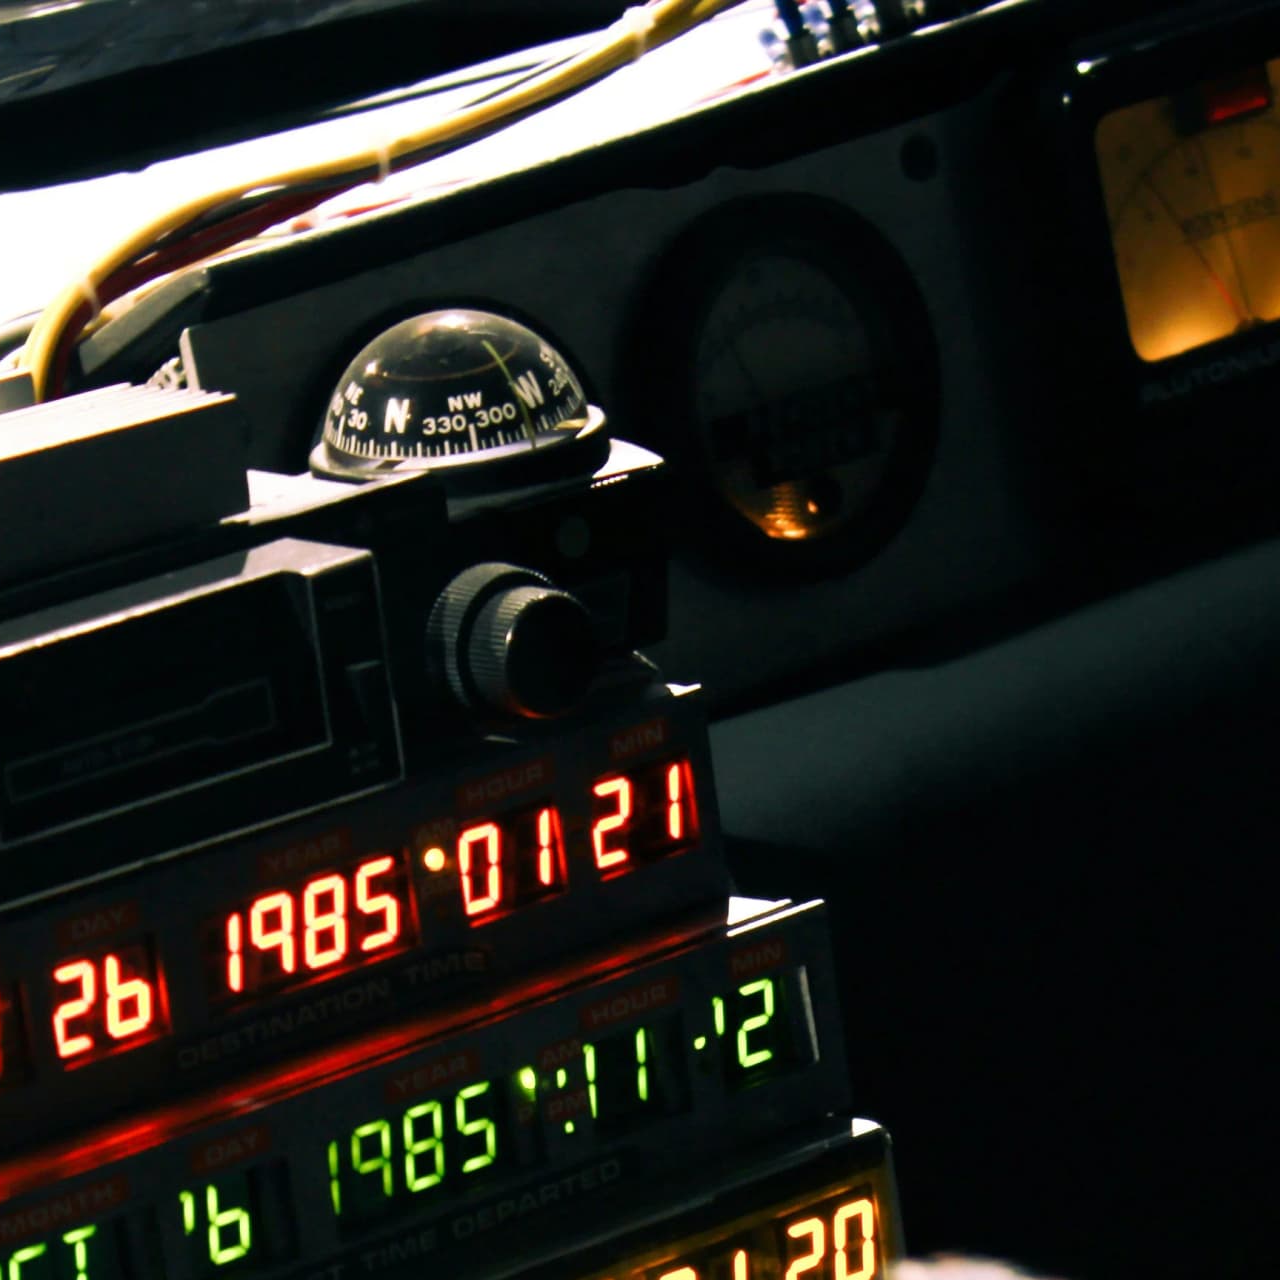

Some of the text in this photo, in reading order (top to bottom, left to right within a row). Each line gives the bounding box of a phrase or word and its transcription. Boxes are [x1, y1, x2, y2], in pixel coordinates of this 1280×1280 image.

[347, 408, 369, 431] 30
[382, 397, 410, 435] N
[422, 413, 466, 436] 330
[476, 401, 517, 429] 300
[514, 369, 545, 410] W
[447, 389, 483, 413] NW
[71, 903, 130, 941] DAY
[263, 832, 341, 873] YEAR
[464, 762, 545, 804] HOUR
[611, 721, 665, 757] MIN
[52, 953, 155, 1058] 26
[225, 854, 402, 993] 1985
[176, 950, 489, 1070] DESTINATION TIME
[0, 943, 783, 1236] MONTH DAY YEAR HOUR MIN
[327, 1079, 498, 1217] 1985
[359, 1225, 438, 1272] TIME
[450, 1158, 622, 1242] DEPARTED
